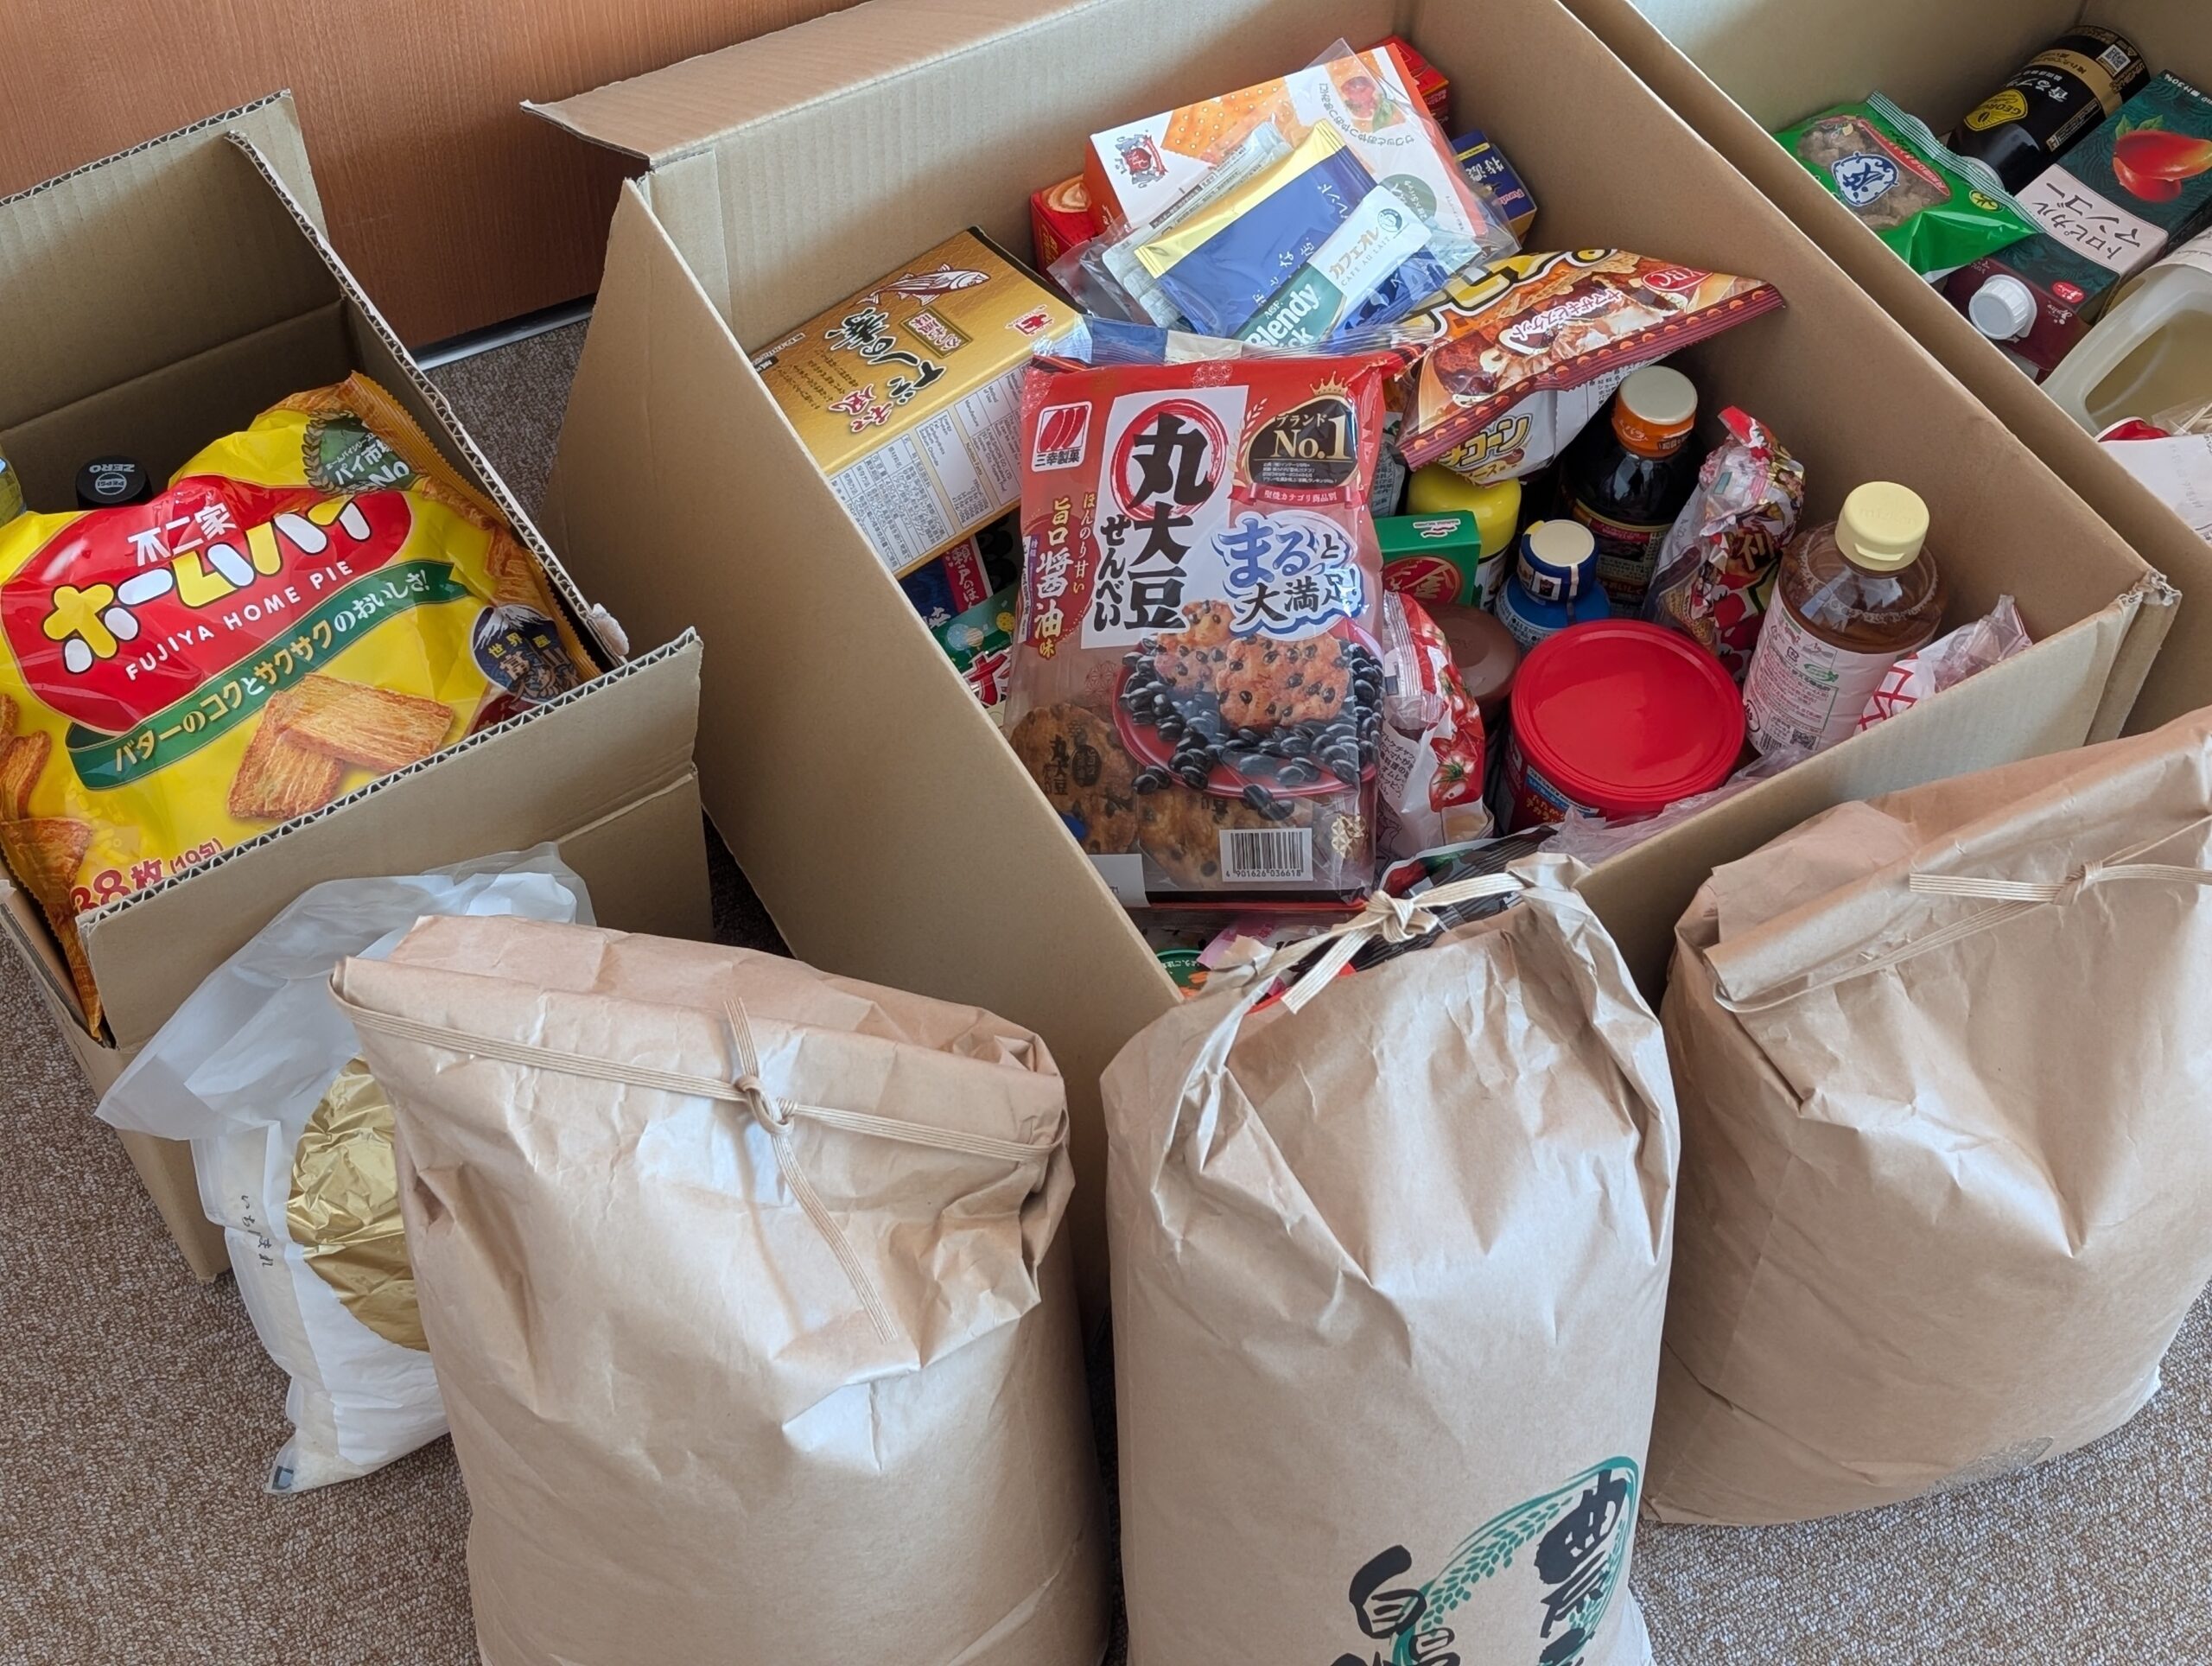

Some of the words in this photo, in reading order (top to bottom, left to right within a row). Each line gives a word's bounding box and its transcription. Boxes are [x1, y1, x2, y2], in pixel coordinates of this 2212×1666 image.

[1317, 183, 1349, 219] レンド
[2046, 182, 2140, 248] マンゴー
[1329, 226, 1380, 280] カフェオレ
[2032, 202, 2122, 260] トロピカル
[1656, 268, 1702, 288] YBC
[1244, 283, 1320, 346] Blendy
[1512, 289, 1624, 341] ヤマザキビスケット
[825, 308, 947, 405] だしの素
[828, 382, 894, 433] 和風
[1276, 412, 1327, 429] ブランド
[1034, 449, 1081, 467] 三幸製菓
[1270, 414, 1351, 461] No.1
[89, 463, 136, 474] ZERO
[128, 501, 238, 568] 不二家
[1071, 492, 1096, 594] ほんのり甘い
[1124, 411, 1214, 631] 丸大豆
[1094, 515, 1129, 633] せんべい
[125, 625, 216, 682] FUJIYA
[222, 583, 303, 631] HOME
[308, 560, 354, 591] PIE
[114, 569, 431, 772] バターのコクとサクサクのおいしさ!
[1236, 869, 1266, 878] 901626
[240, 1194, 274, 1268] いちまれ
